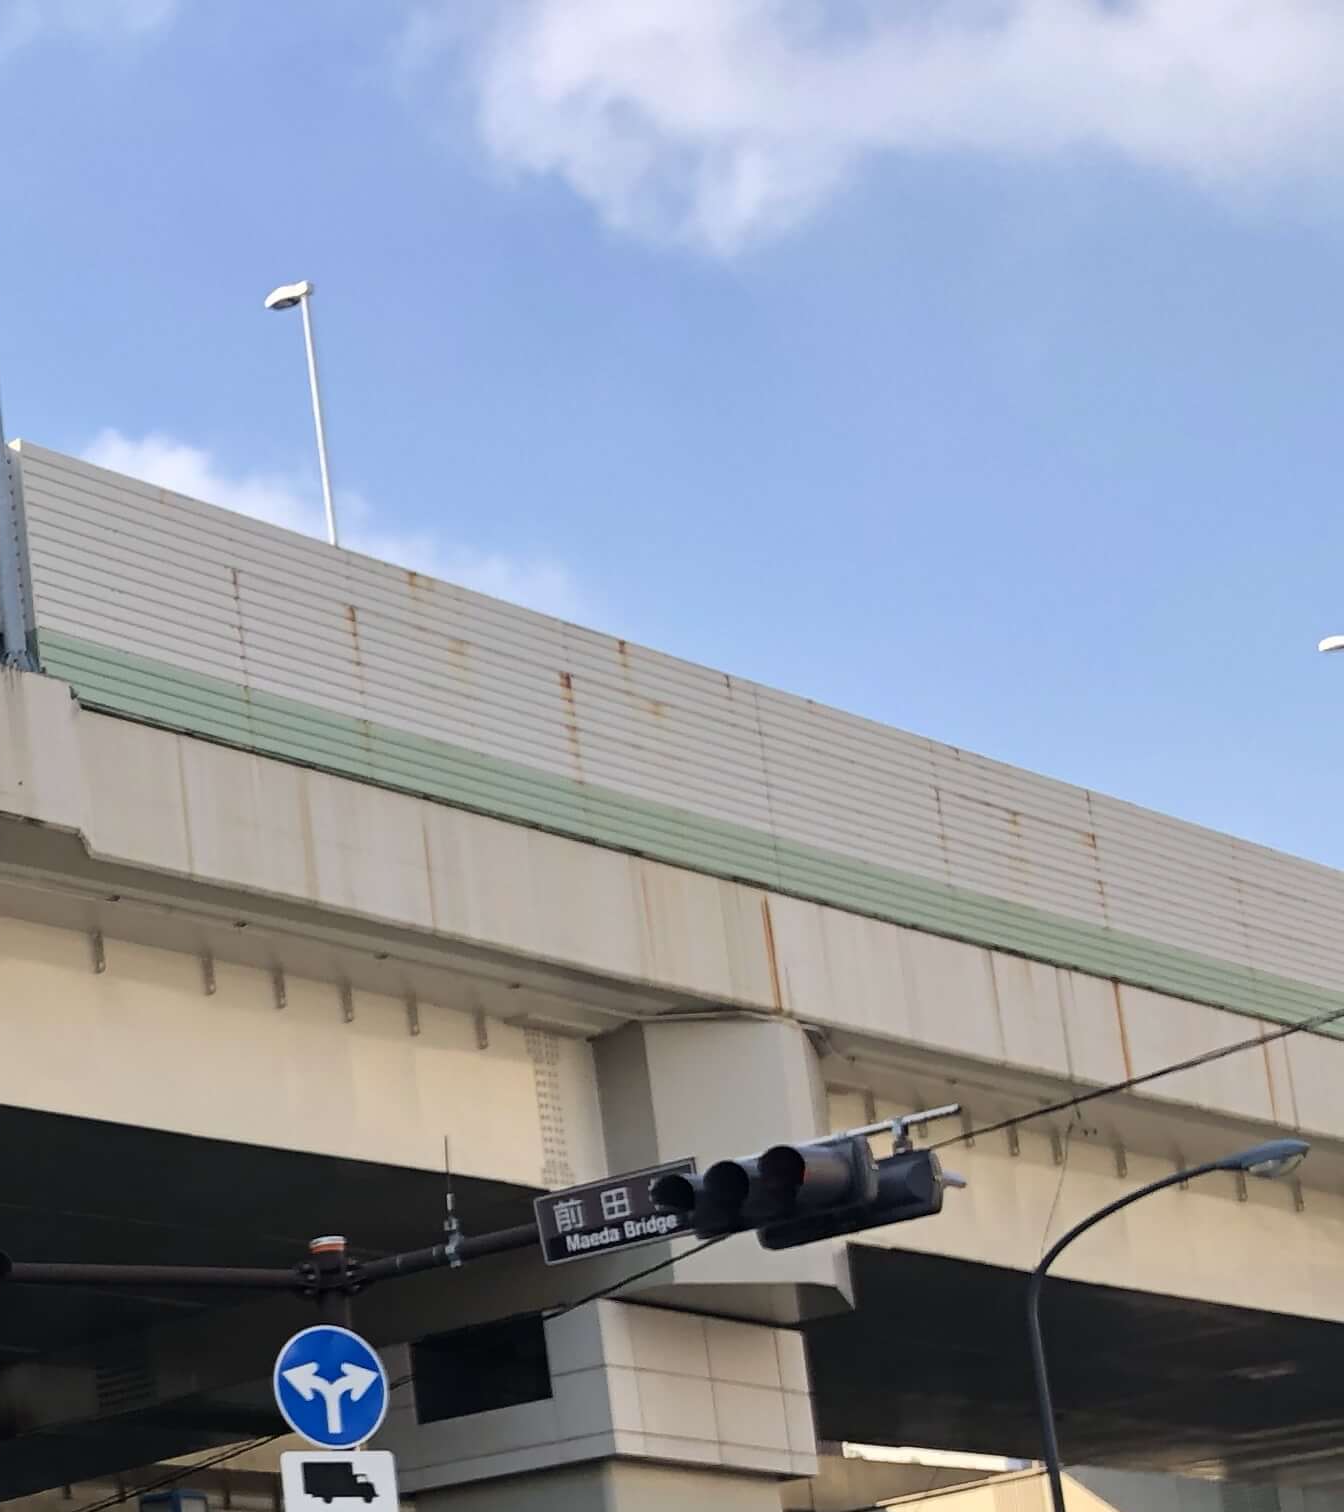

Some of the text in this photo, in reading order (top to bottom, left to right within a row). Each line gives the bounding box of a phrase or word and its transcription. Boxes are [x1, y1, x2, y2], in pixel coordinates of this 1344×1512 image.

[553, 1177, 659, 1234] 前田
[565, 1213, 679, 1253] Maeda Bridge
